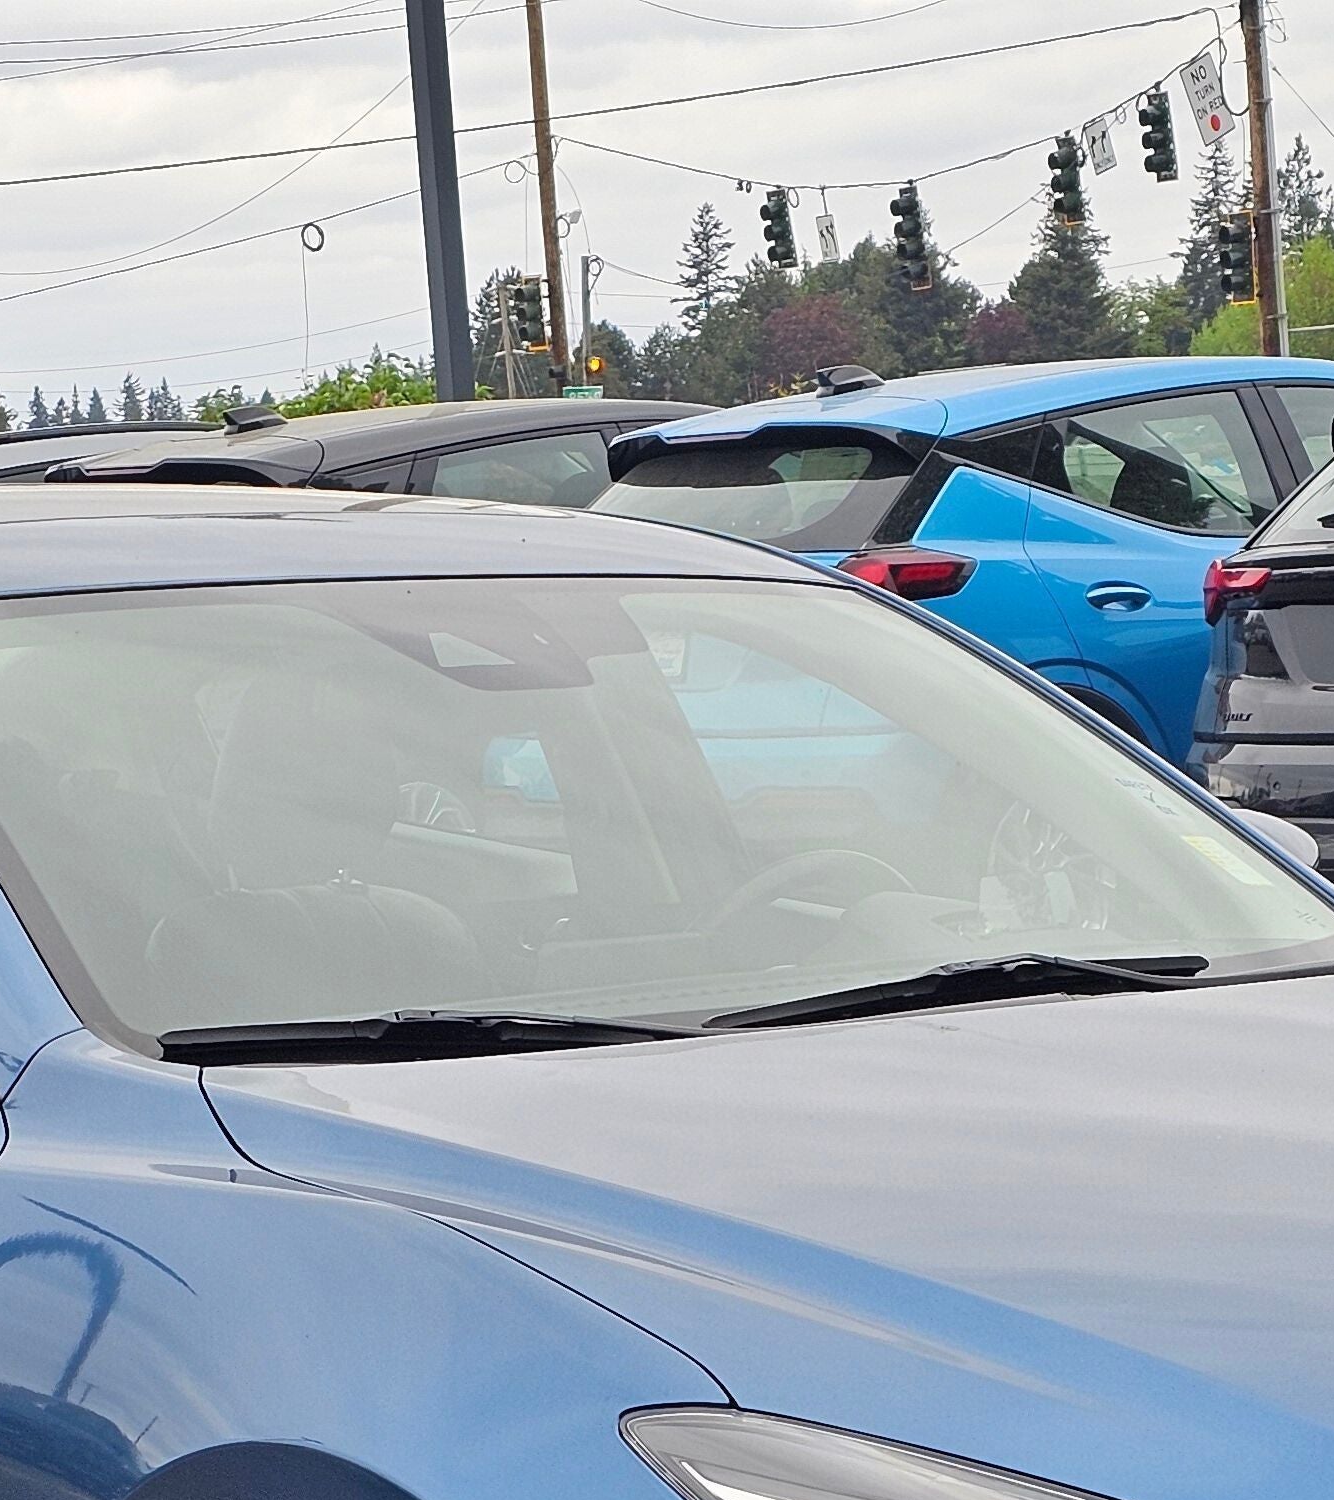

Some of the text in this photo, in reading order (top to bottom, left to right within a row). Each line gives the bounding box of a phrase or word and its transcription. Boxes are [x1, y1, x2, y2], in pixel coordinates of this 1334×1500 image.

[1190, 65, 1207, 85] NO
[1195, 83, 1215, 101] TURN
[1197, 95, 1223, 120] ON RED
